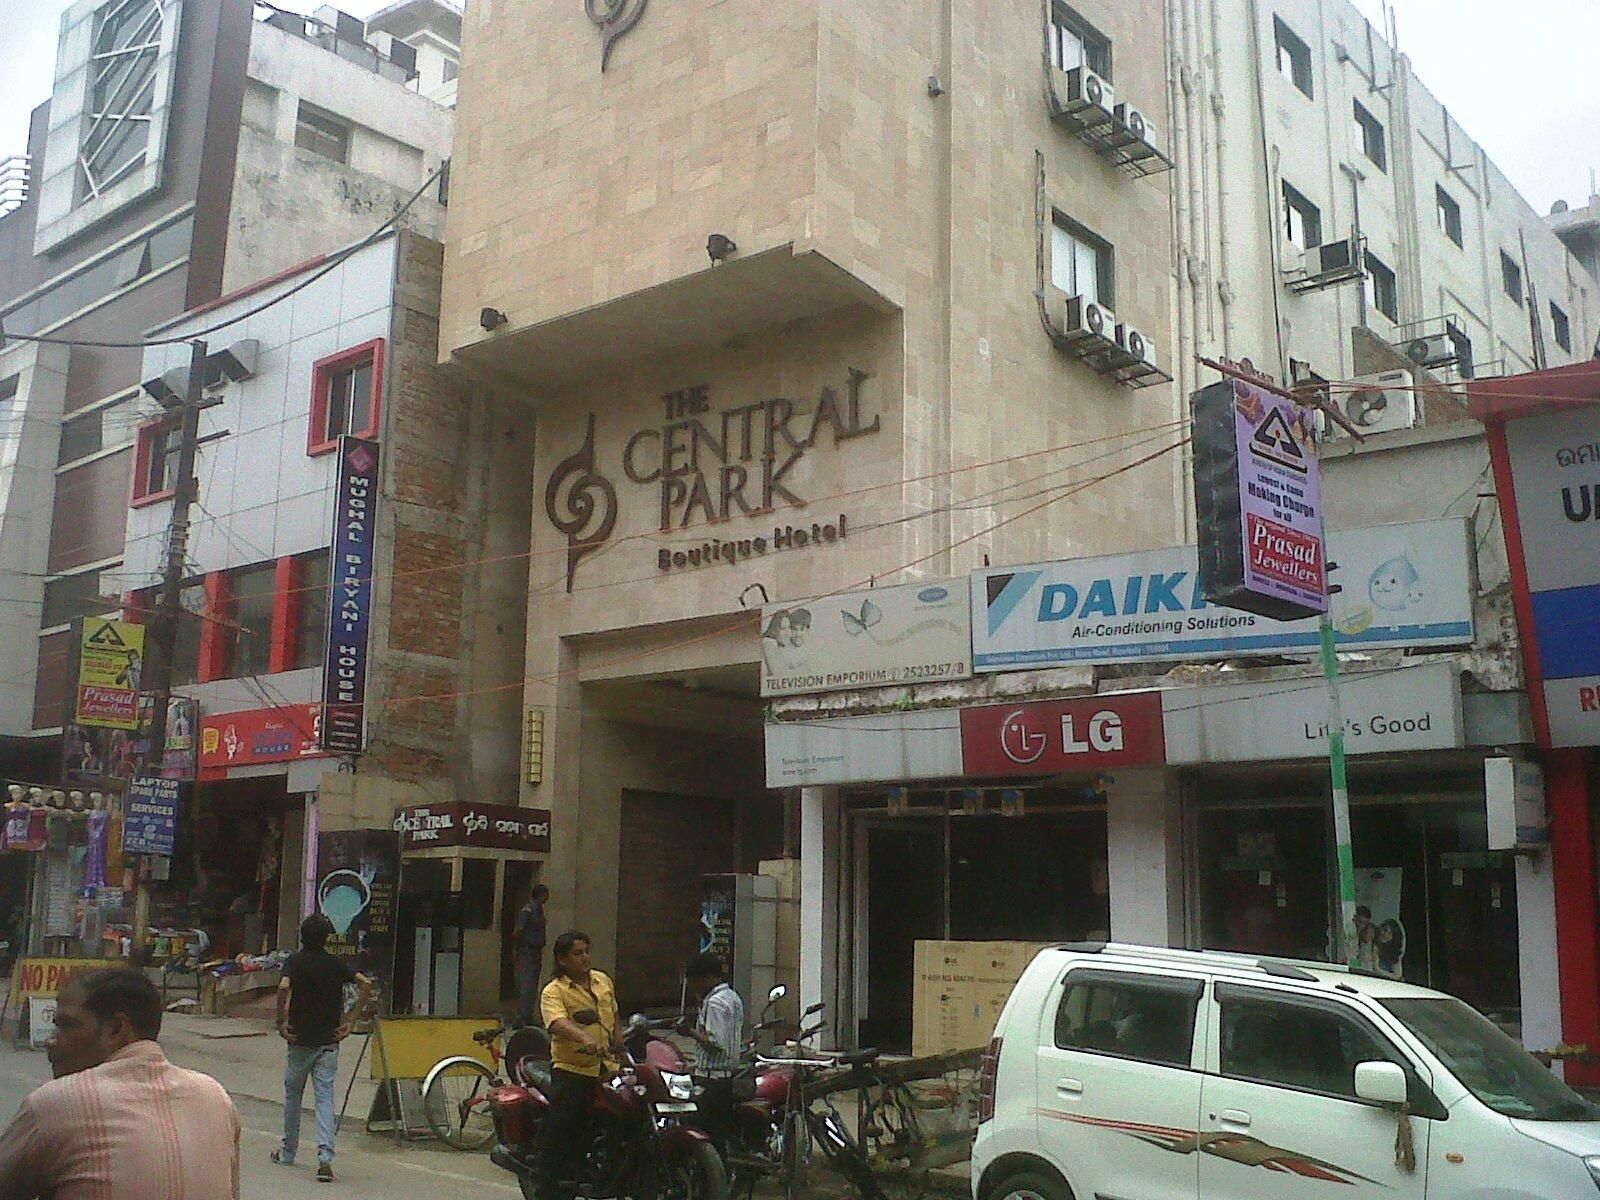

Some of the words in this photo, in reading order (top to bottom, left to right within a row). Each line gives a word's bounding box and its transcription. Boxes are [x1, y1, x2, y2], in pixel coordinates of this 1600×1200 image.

[663, 384, 710, 420] THE
[623, 368, 882, 484] CENTRAL
[660, 448, 810, 535] PARK
[1248, 481, 1281, 508] Making
[1282, 494, 1315, 519] Charge
[1561, 484, 1600, 522] U
[658, 539, 767, 571] Boutique
[774, 513, 847, 549] Hotel
[1253, 522, 1317, 566] Prasad
[1254, 548, 1319, 583] Jewellers
[341, 553, 363, 632] BIRYANI
[1037, 571, 1225, 622] DAIKI
[1072, 619, 1183, 640] Air-Conditioning
[1187, 614, 1256, 630] Solutions
[337, 644, 358, 702] HOUSE
[766, 675, 824, 690] TELEVISION
[826, 669, 887, 686] EMPORIUM
[83, 686, 135, 705] Prasad
[1580, 686, 1600, 712] R
[1061, 709, 1124, 754] LG
[1370, 712, 1431, 737] Good
[132, 776, 179, 789] LAPTOP
[130, 803, 174, 816] SERVICES
[412, 830, 439, 842] PARK
[21, 964, 43, 992] NO
